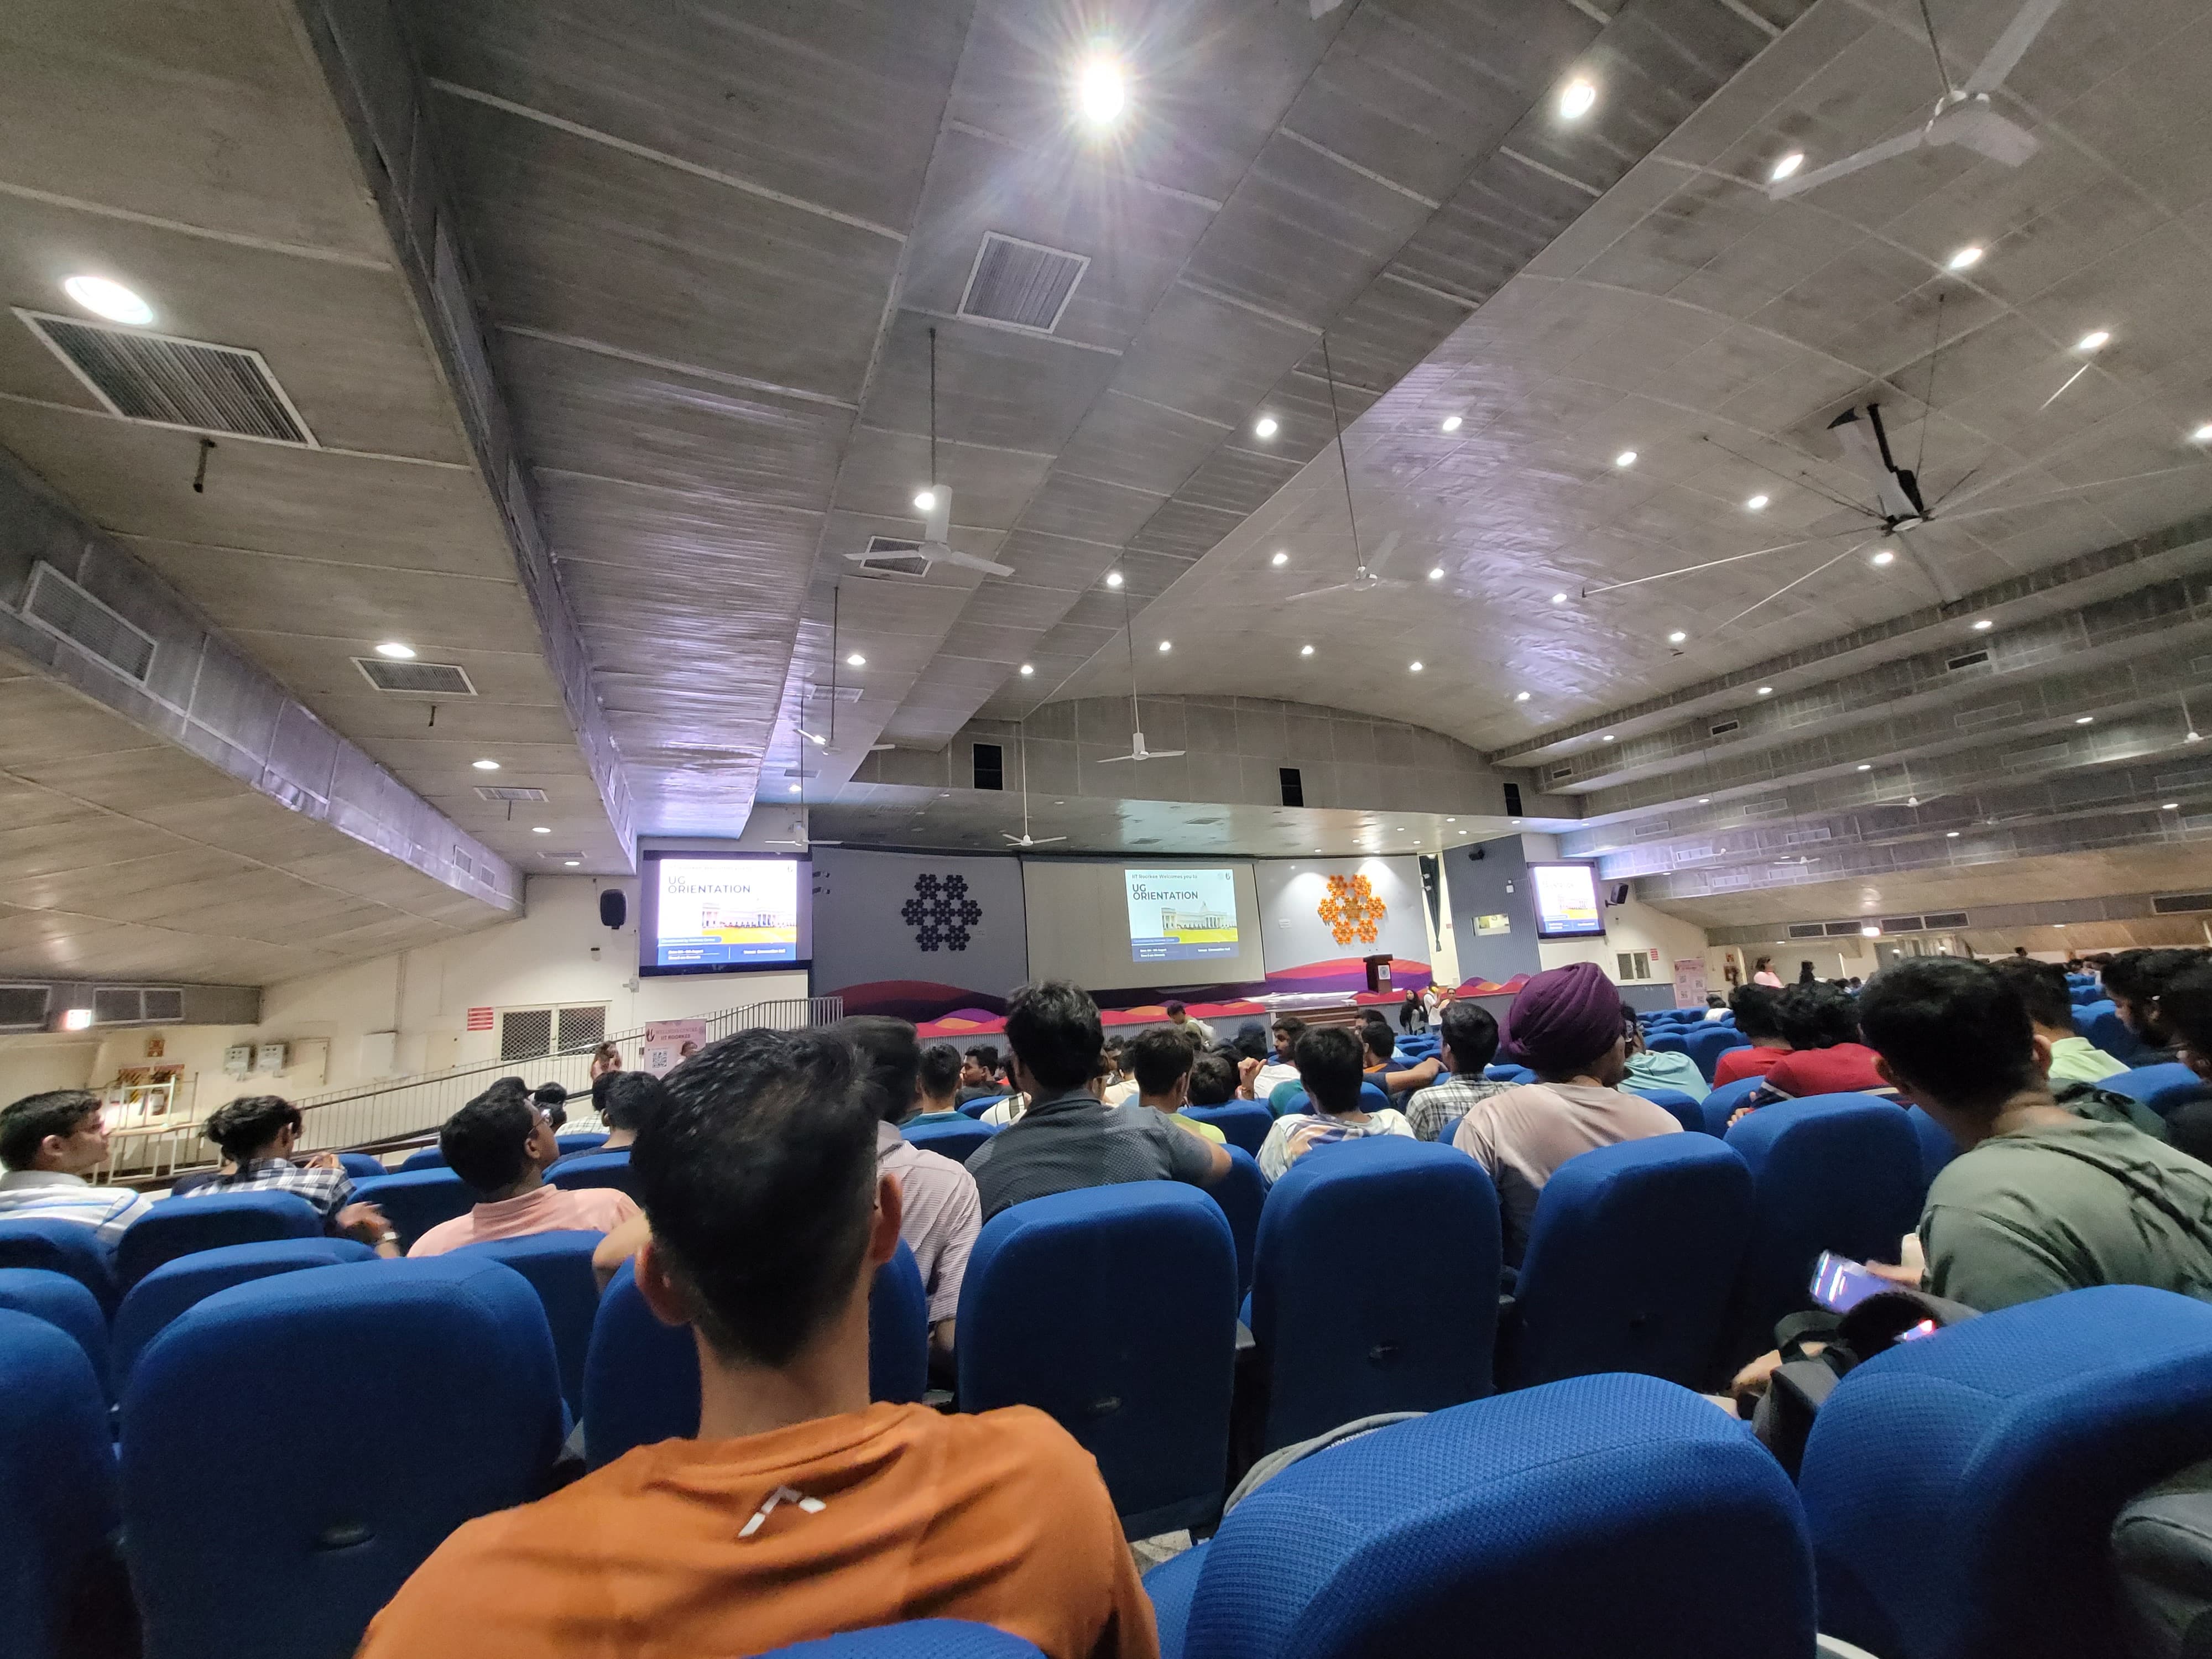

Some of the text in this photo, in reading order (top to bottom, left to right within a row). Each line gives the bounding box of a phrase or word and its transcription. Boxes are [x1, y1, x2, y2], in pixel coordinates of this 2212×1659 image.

[668, 876, 686, 884] UG
[668, 885, 751, 894] ORIENTATION
[1132, 884, 1146, 892] UG
[1133, 891, 1198, 900] ORIENTATION
